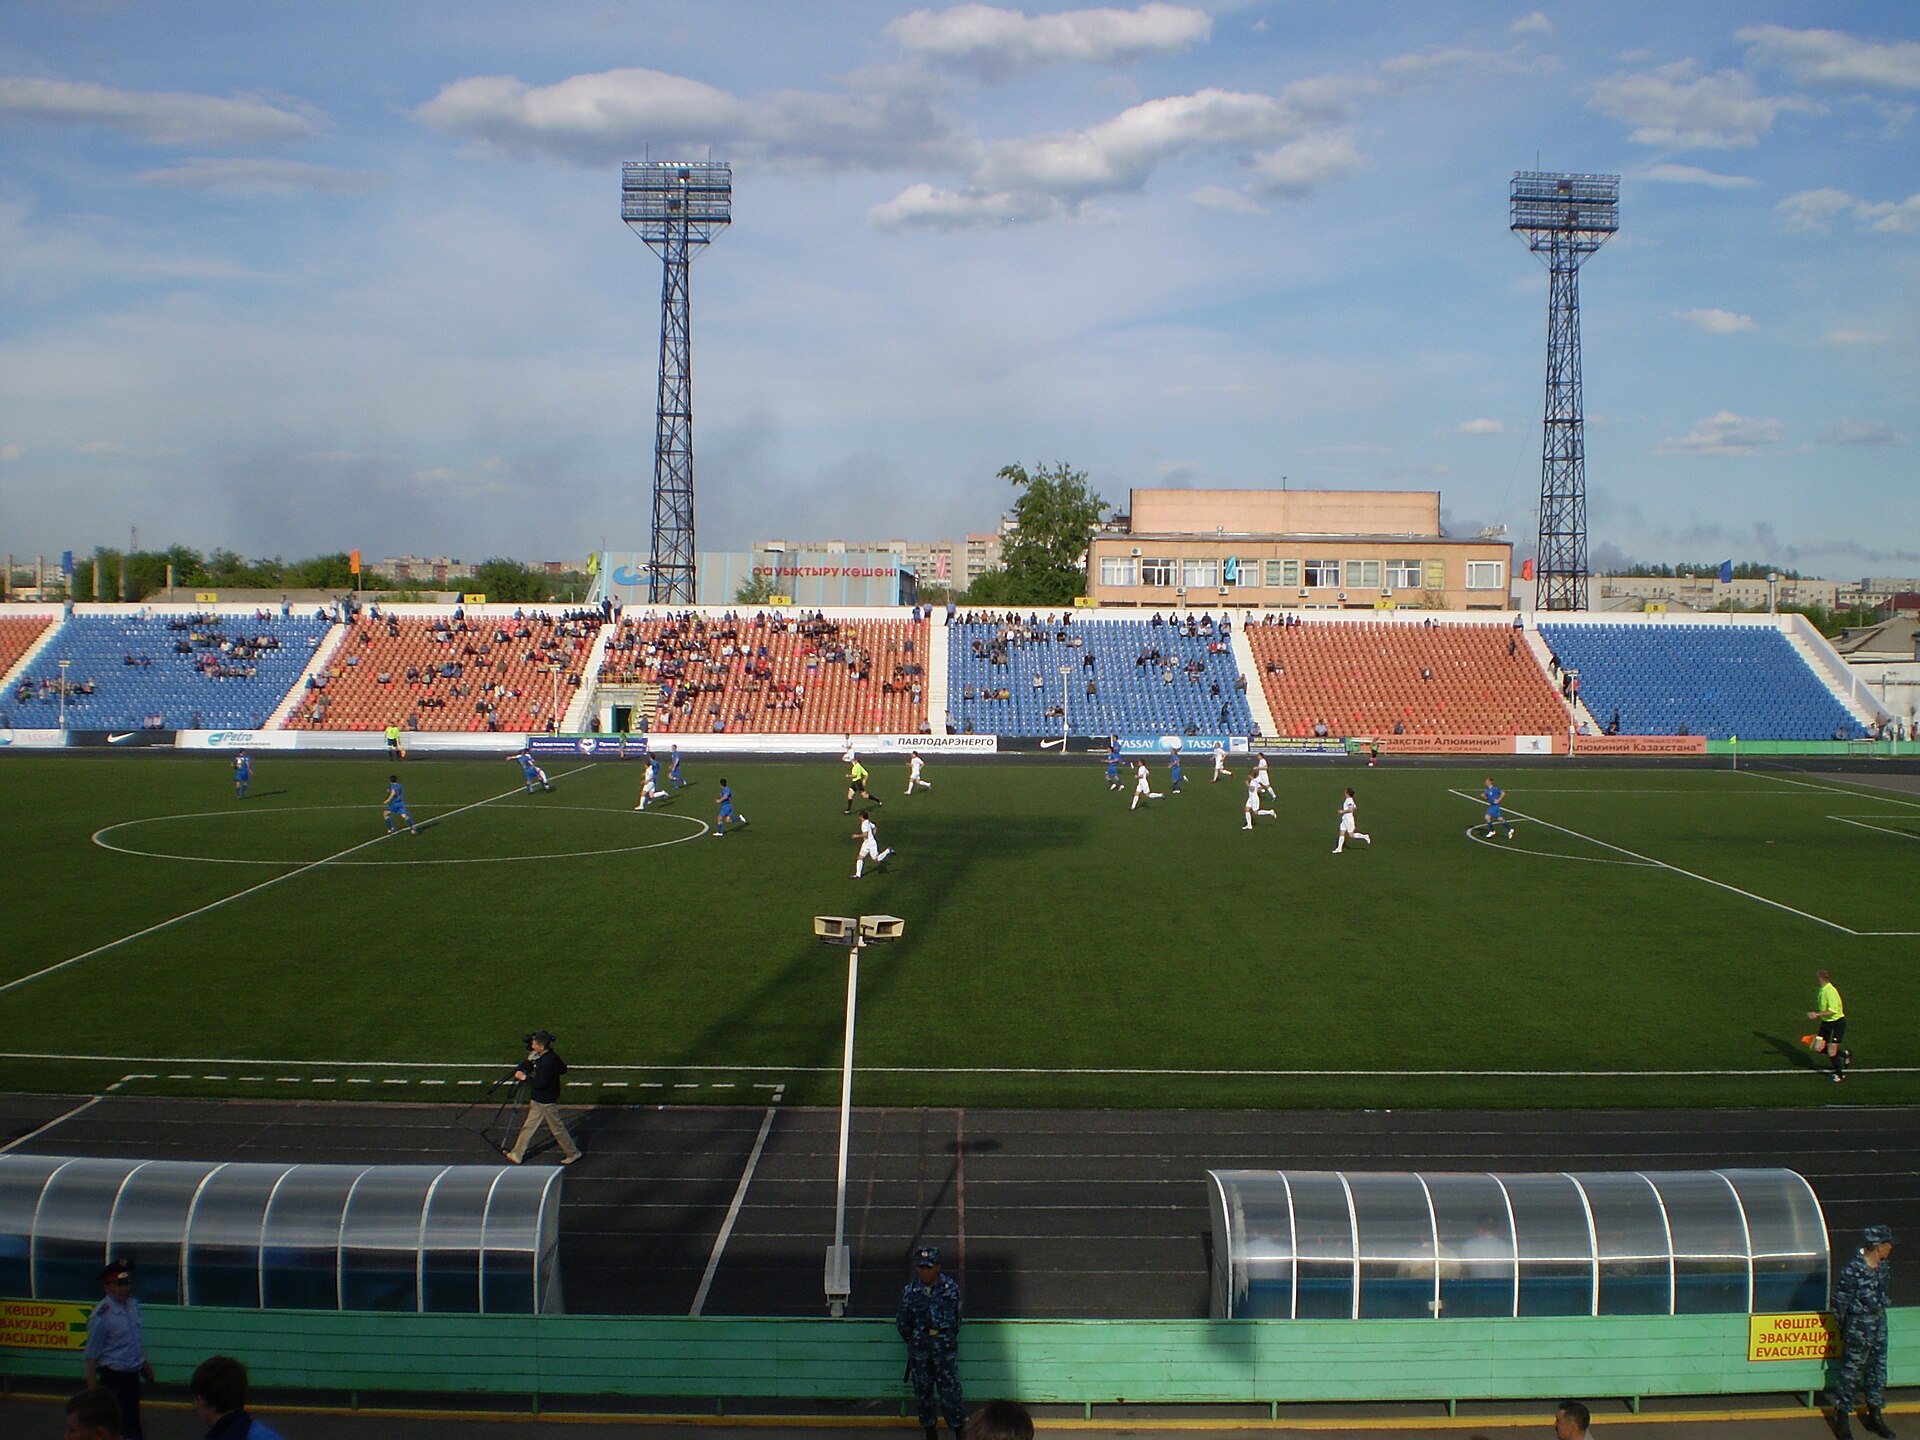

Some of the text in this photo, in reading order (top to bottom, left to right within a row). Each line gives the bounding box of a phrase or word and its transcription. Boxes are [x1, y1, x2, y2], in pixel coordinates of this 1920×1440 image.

[224, 731, 253, 742] Petro
[898, 738, 994, 746] ПАВЛОДАРЭНЕРГО
[1117, 739, 1225, 748] TASSAY TASSAY
[0, 1318, 66, 1331] ВАКУАЦИЯ
[1774, 1318, 1827, 1329] КӨШІРУ
[1758, 1332, 1836, 1344] ЭВАКУАЦИЯ
[1756, 1344, 1837, 1358] EVACUATION
